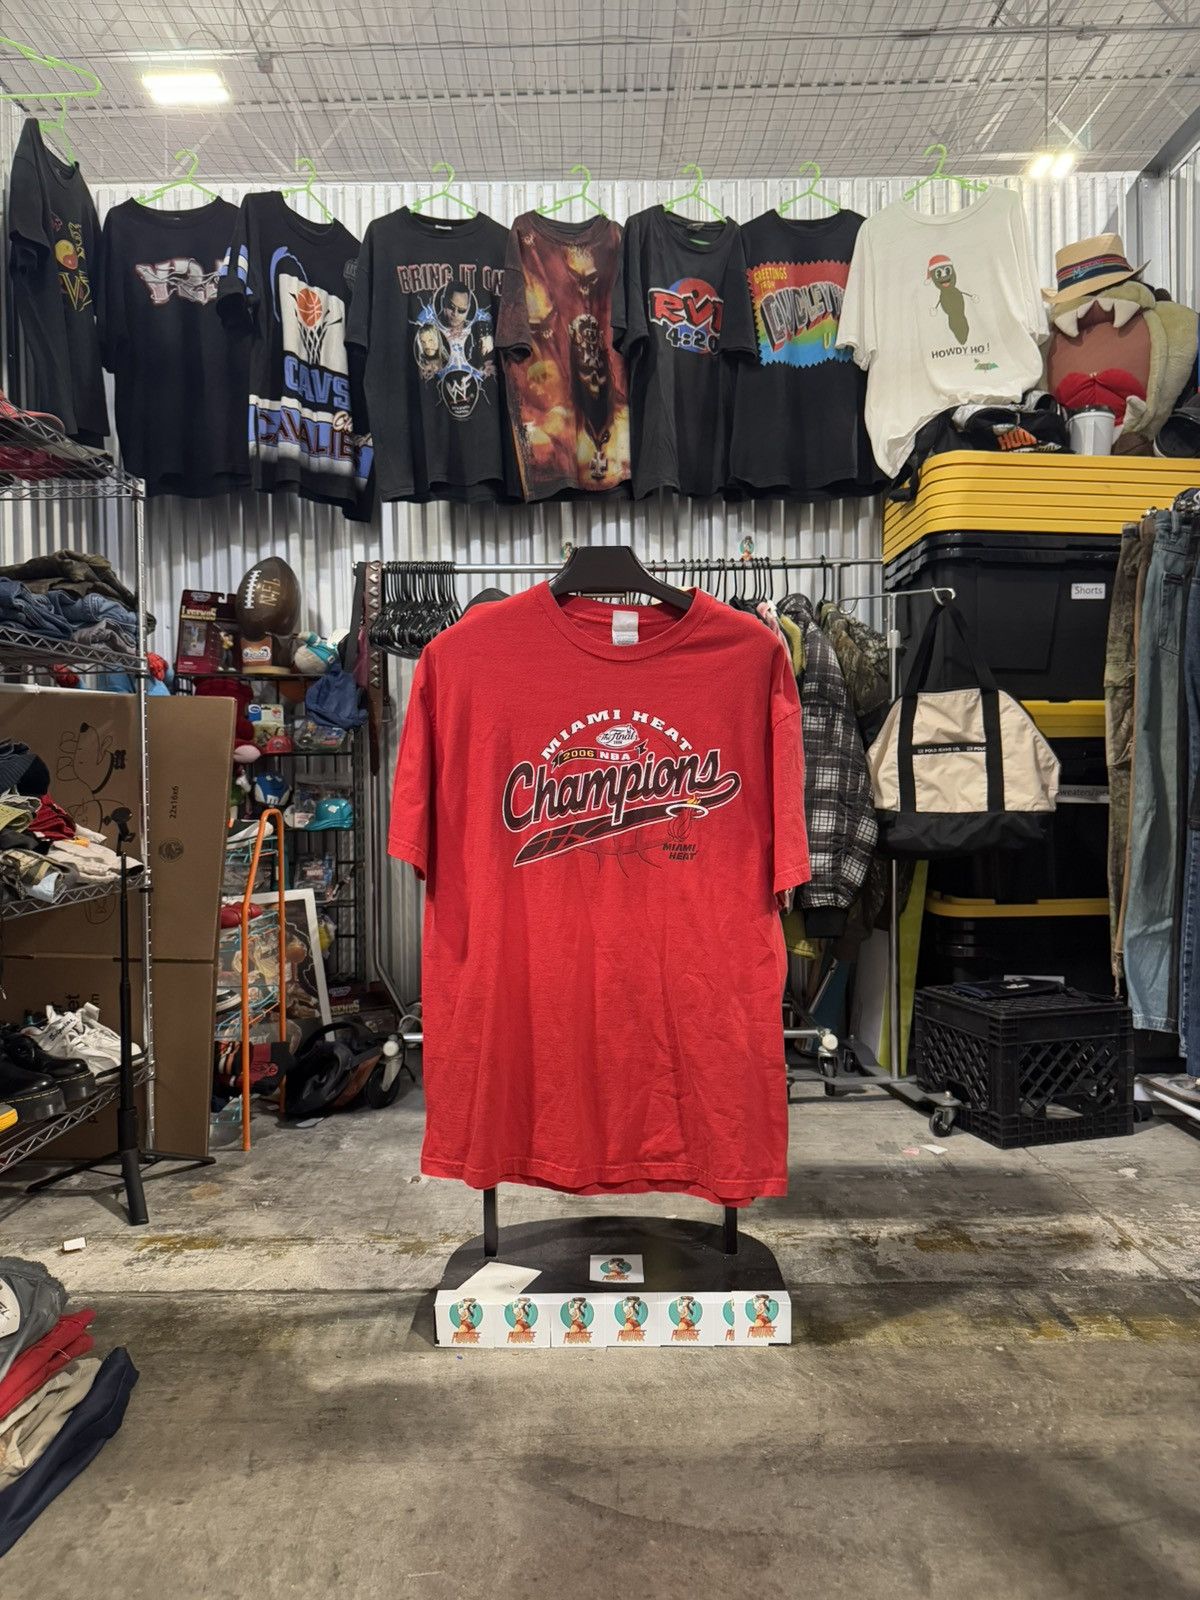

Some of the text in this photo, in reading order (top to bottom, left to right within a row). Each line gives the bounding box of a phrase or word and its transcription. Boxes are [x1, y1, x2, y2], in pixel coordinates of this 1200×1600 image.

[397, 263, 453, 294] BRING
[459, 264, 477, 292] IT
[666, 326, 720, 355] 4:20
[931, 346, 968, 359] HOWDY
[284, 355, 352, 411] CAVS
[1074, 585, 1103, 595] Shorts
[541, 709, 693, 761] MIAMI HEAT
[562, 749, 631, 762] 2006 NBA
[502, 749, 726, 833] Champions
[662, 843, 697, 851] MIAMI
[669, 851, 698, 861] HEAT
